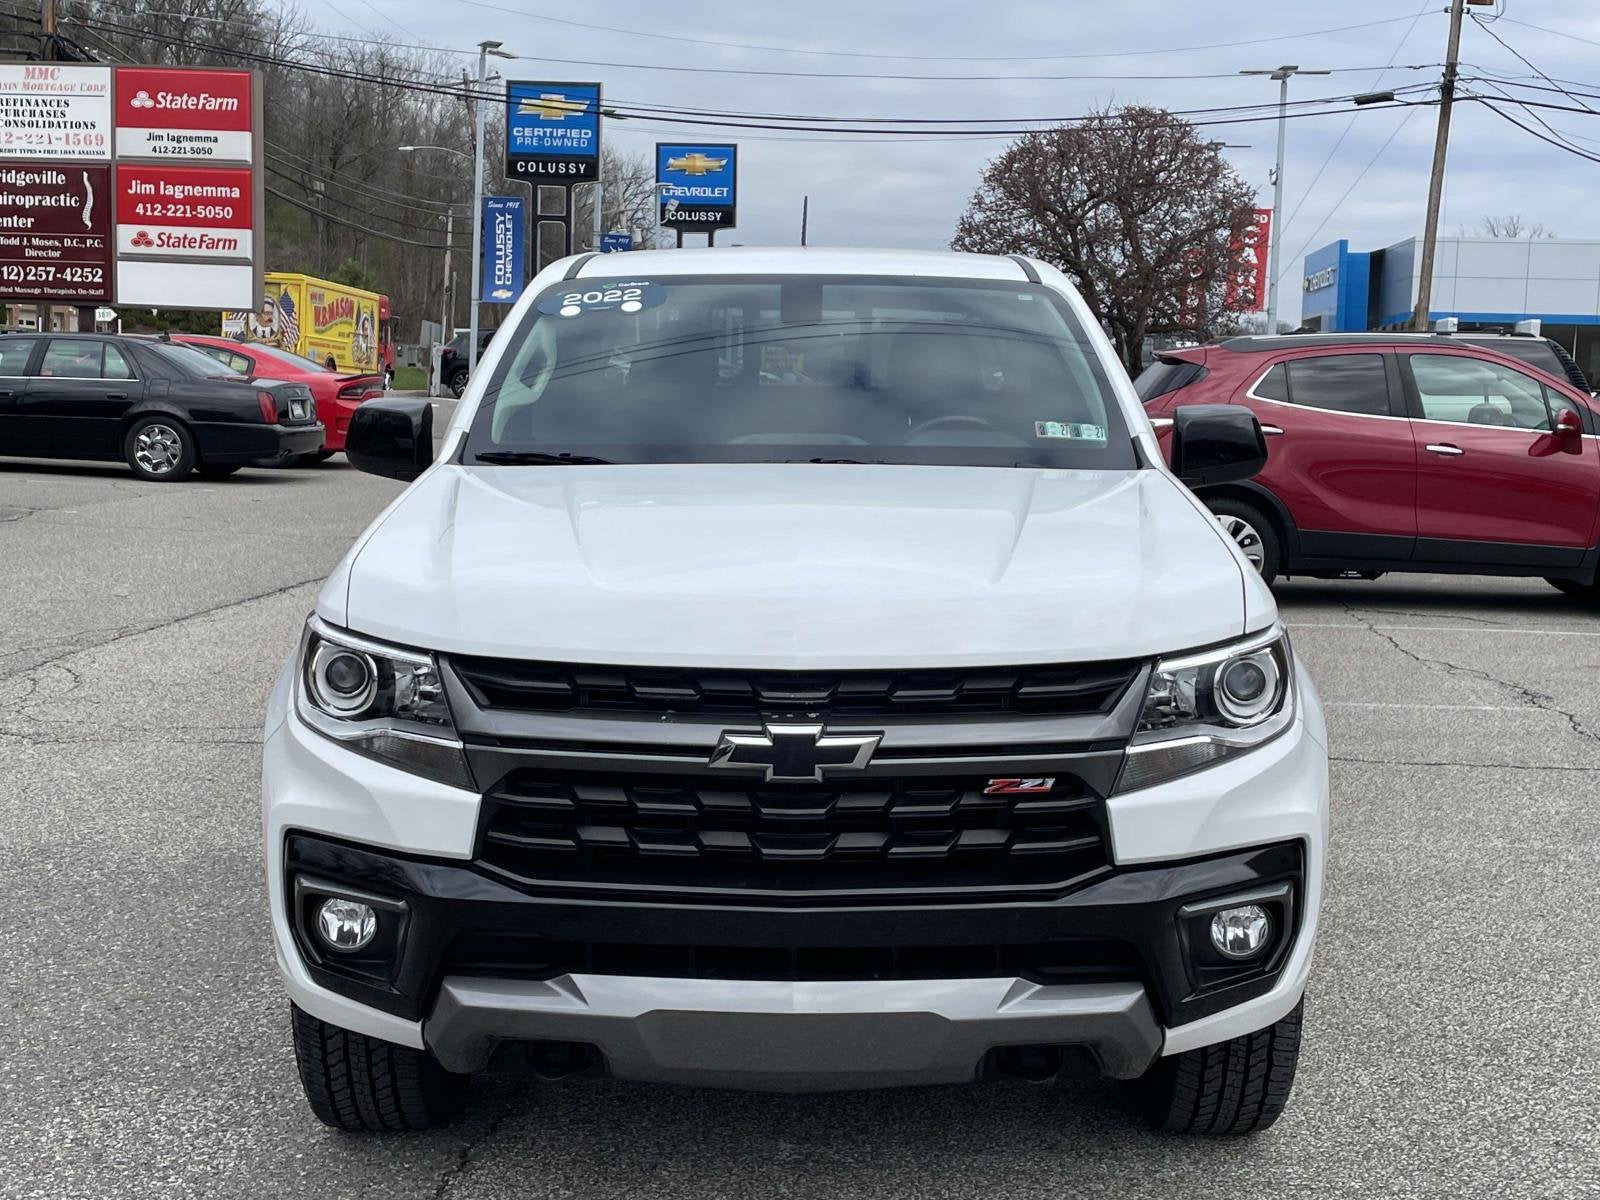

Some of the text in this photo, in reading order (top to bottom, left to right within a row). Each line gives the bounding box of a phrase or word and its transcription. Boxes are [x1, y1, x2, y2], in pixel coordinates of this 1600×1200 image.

[24, 67, 61, 80] MMC
[22, 81, 76, 92] MORTGAGE
[146, 132, 218, 144] Jim Iagnemma
[513, 127, 592, 138] CERTIFIED
[0, 132, 104, 146] 2-221-1569
[516, 137, 588, 147] PRE-OWNED
[152, 145, 213, 156] 412-221-5050
[517, 161, 587, 174] COLUSSY
[0, 170, 66, 188] idgeville
[128, 179, 240, 199] Jim Iagnemma
[662, 186, 729, 197] CHEVROLET
[136, 203, 233, 220] 412-221-5050
[669, 210, 722, 221] COLUSSY
[0, 236, 20, 246] Todd
[25, 248, 62, 258] Director
[495, 213, 505, 285] COLUSSY
[505, 213, 513, 285] CHEVROLET
[0, 265, 103, 283] 12) 257-4252
[14, 286, 42, 295] Massage
[43, 286, 76, 295] Therapists
[563, 288, 642, 306] 2022
